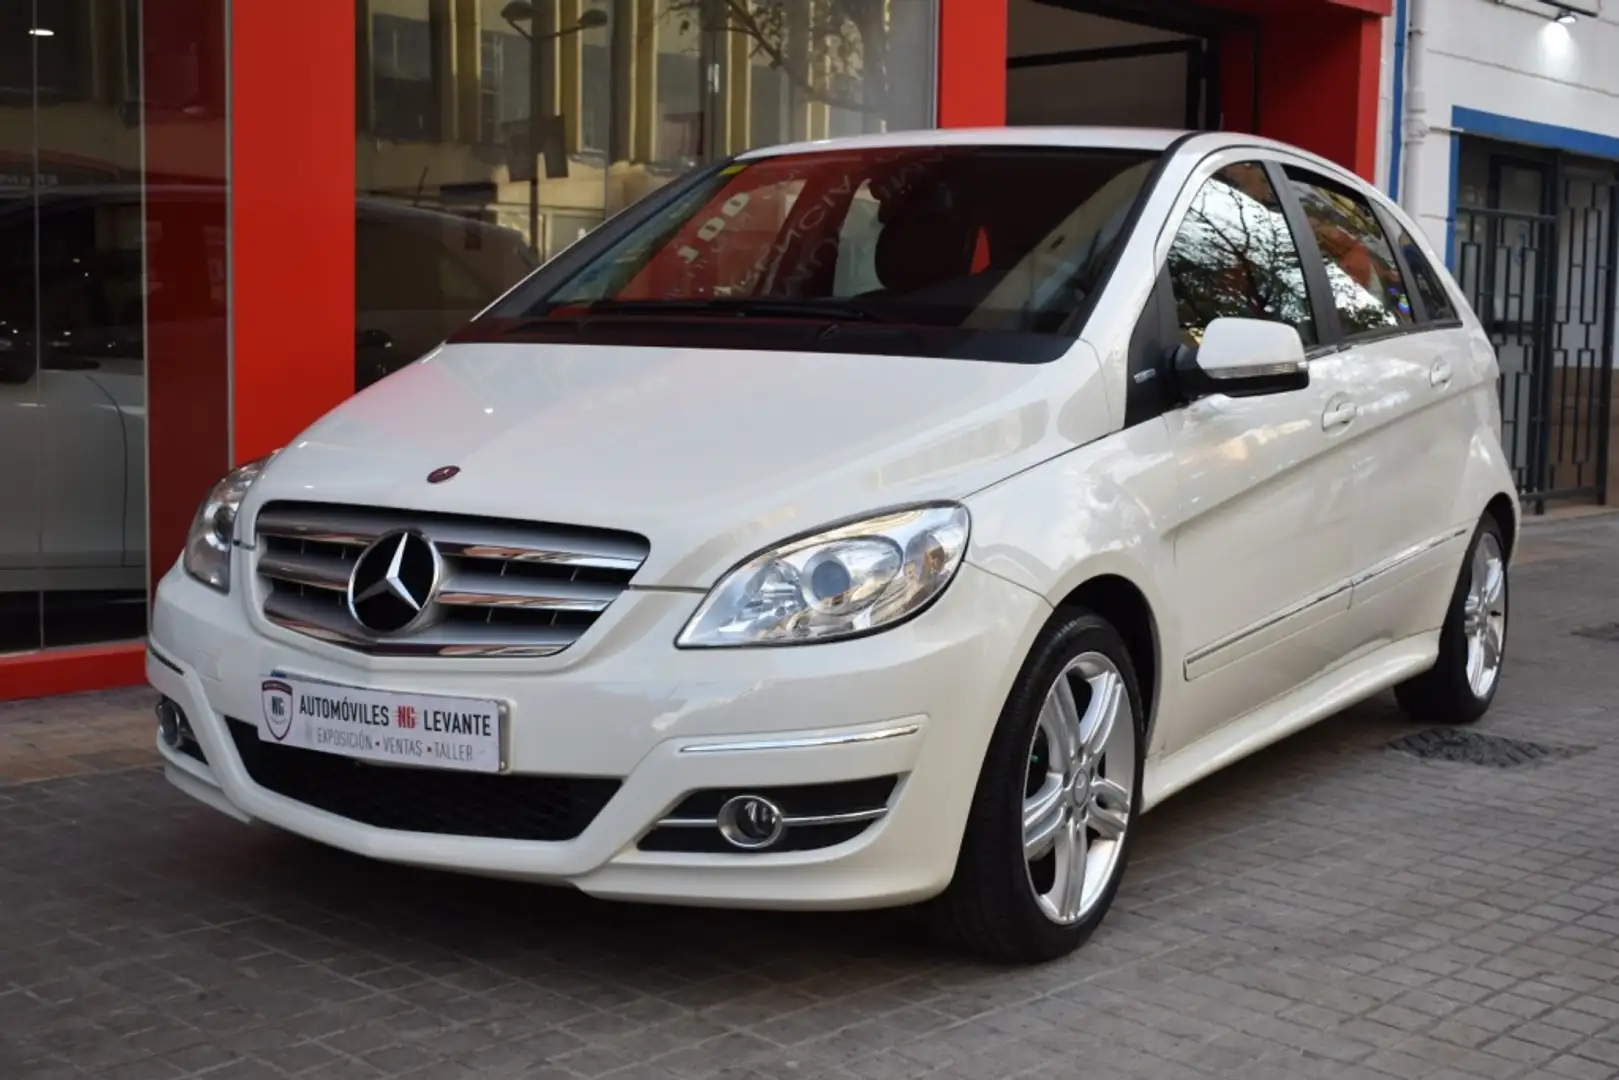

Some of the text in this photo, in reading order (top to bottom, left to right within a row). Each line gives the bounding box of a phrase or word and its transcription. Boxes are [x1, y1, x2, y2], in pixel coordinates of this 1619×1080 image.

[299, 695, 492, 737] AUTOMÓVILES NG LEVANTE
[317, 727, 473, 762] EXPOSICIÓN VENTAS TALLER
